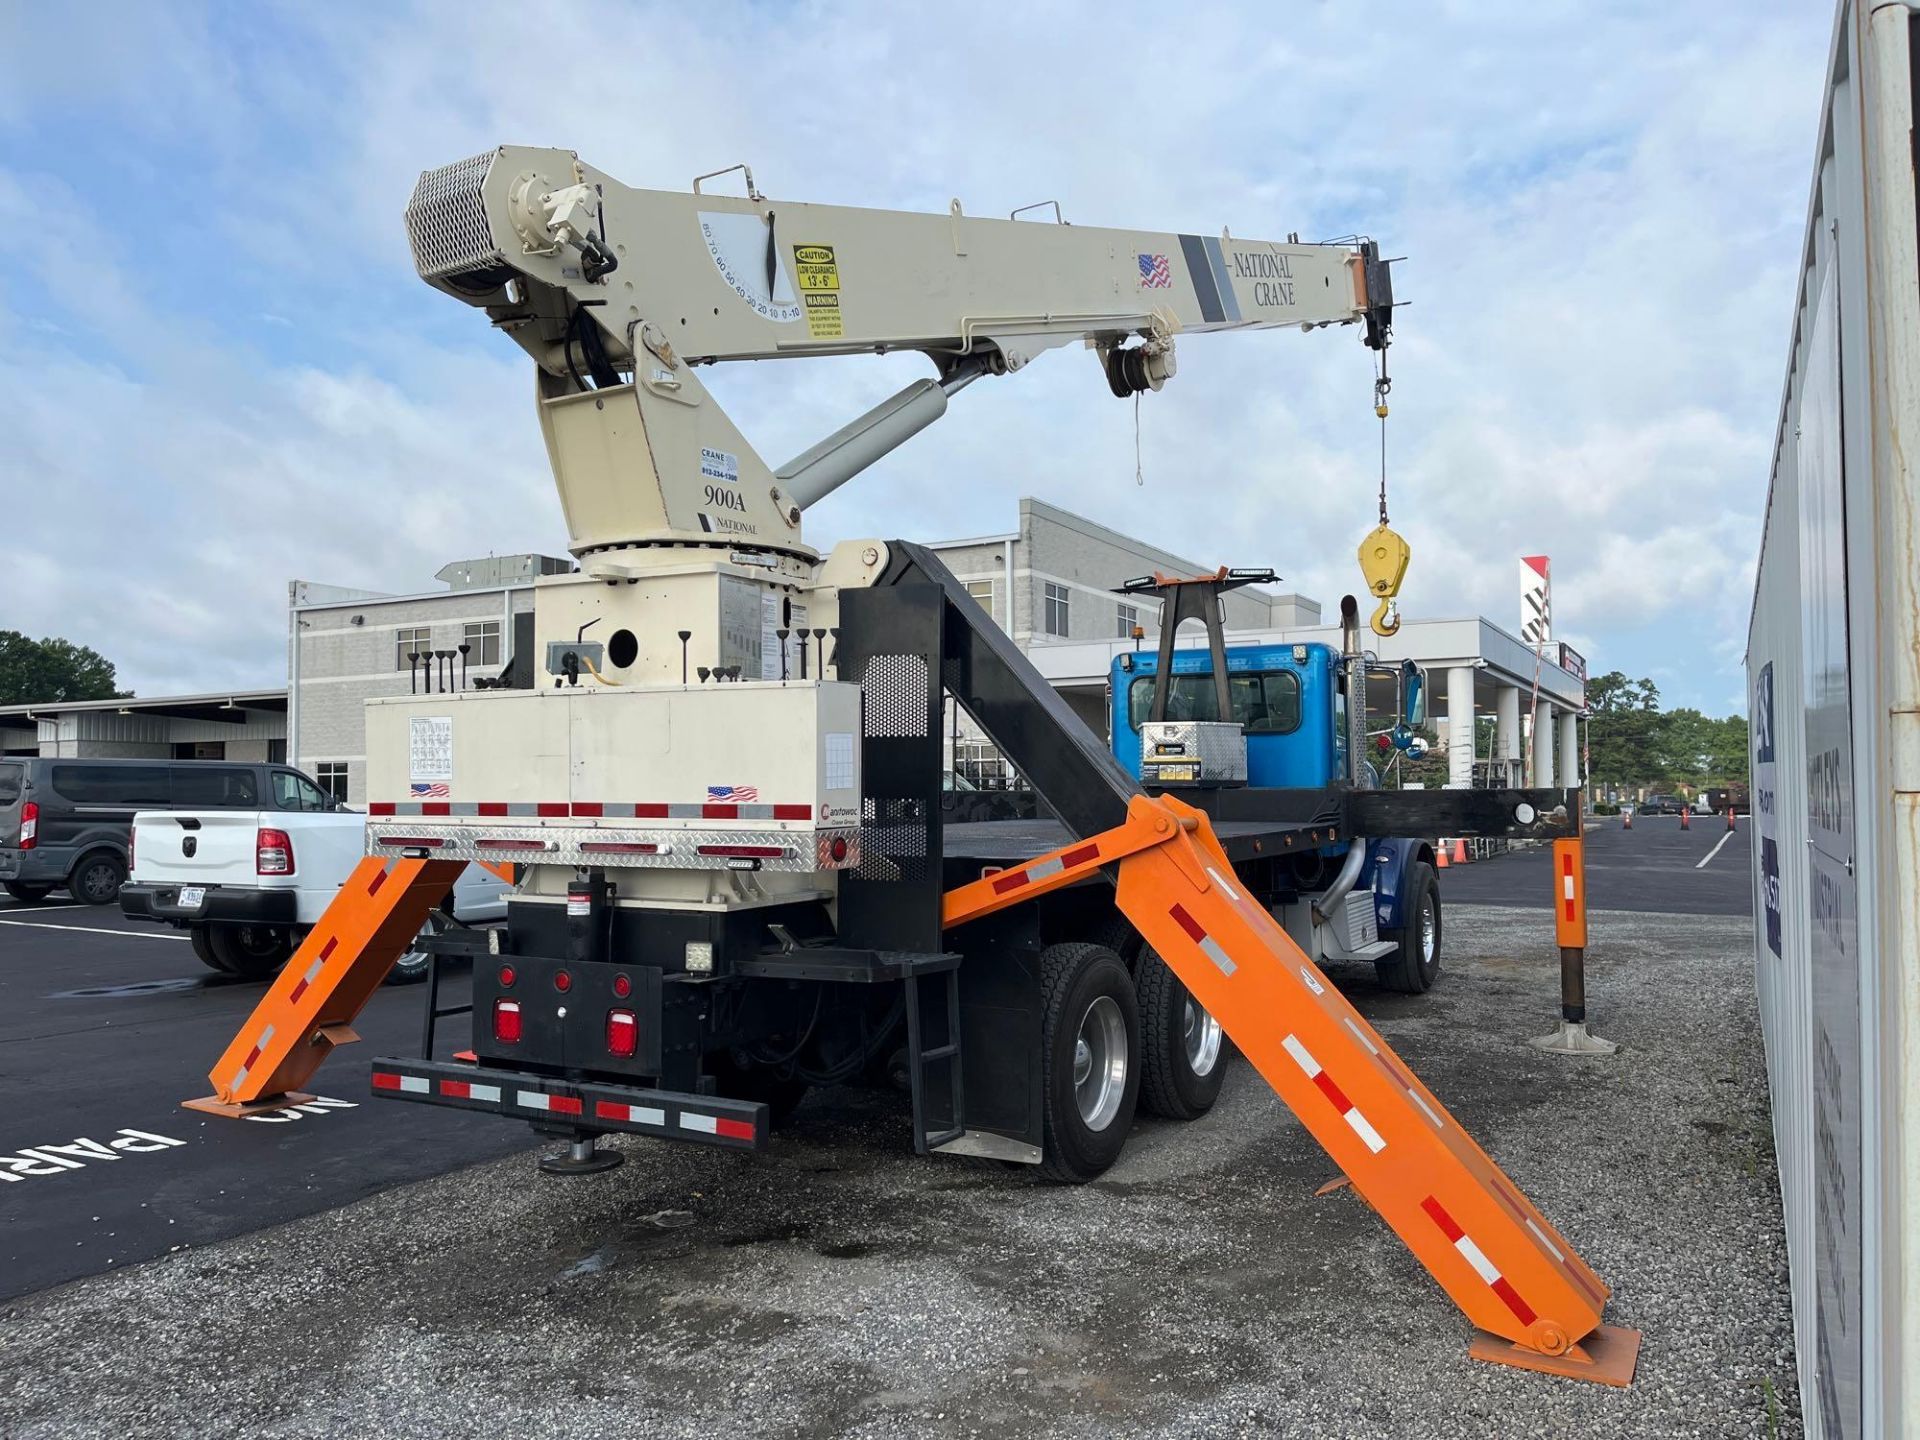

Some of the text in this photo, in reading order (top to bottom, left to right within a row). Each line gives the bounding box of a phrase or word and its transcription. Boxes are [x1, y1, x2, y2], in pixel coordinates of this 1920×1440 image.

[800, 250, 830, 260] CAUTION
[703, 223, 711, 238] 80
[708, 240, 718, 255] 70
[716, 256, 726, 272] 60
[725, 271, 735, 285] 50
[735, 285, 745, 298] 40
[746, 296, 756, 308] 30
[757, 304, 767, 315] 20
[769, 308, 778, 319] 10
[782, 310, 787, 319] 0
[789, 307, 800, 318] -10
[800, 265, 835, 274] LOW CLEARANCE
[1233, 252, 1293, 279] NATIONAL
[806, 295, 837, 306] WARNING
[1255, 282, 1296, 307] CRANE
[701, 448, 725, 461] CRANE
[704, 484, 747, 512] 900A
[716, 516, 758, 534] NATIONAL
